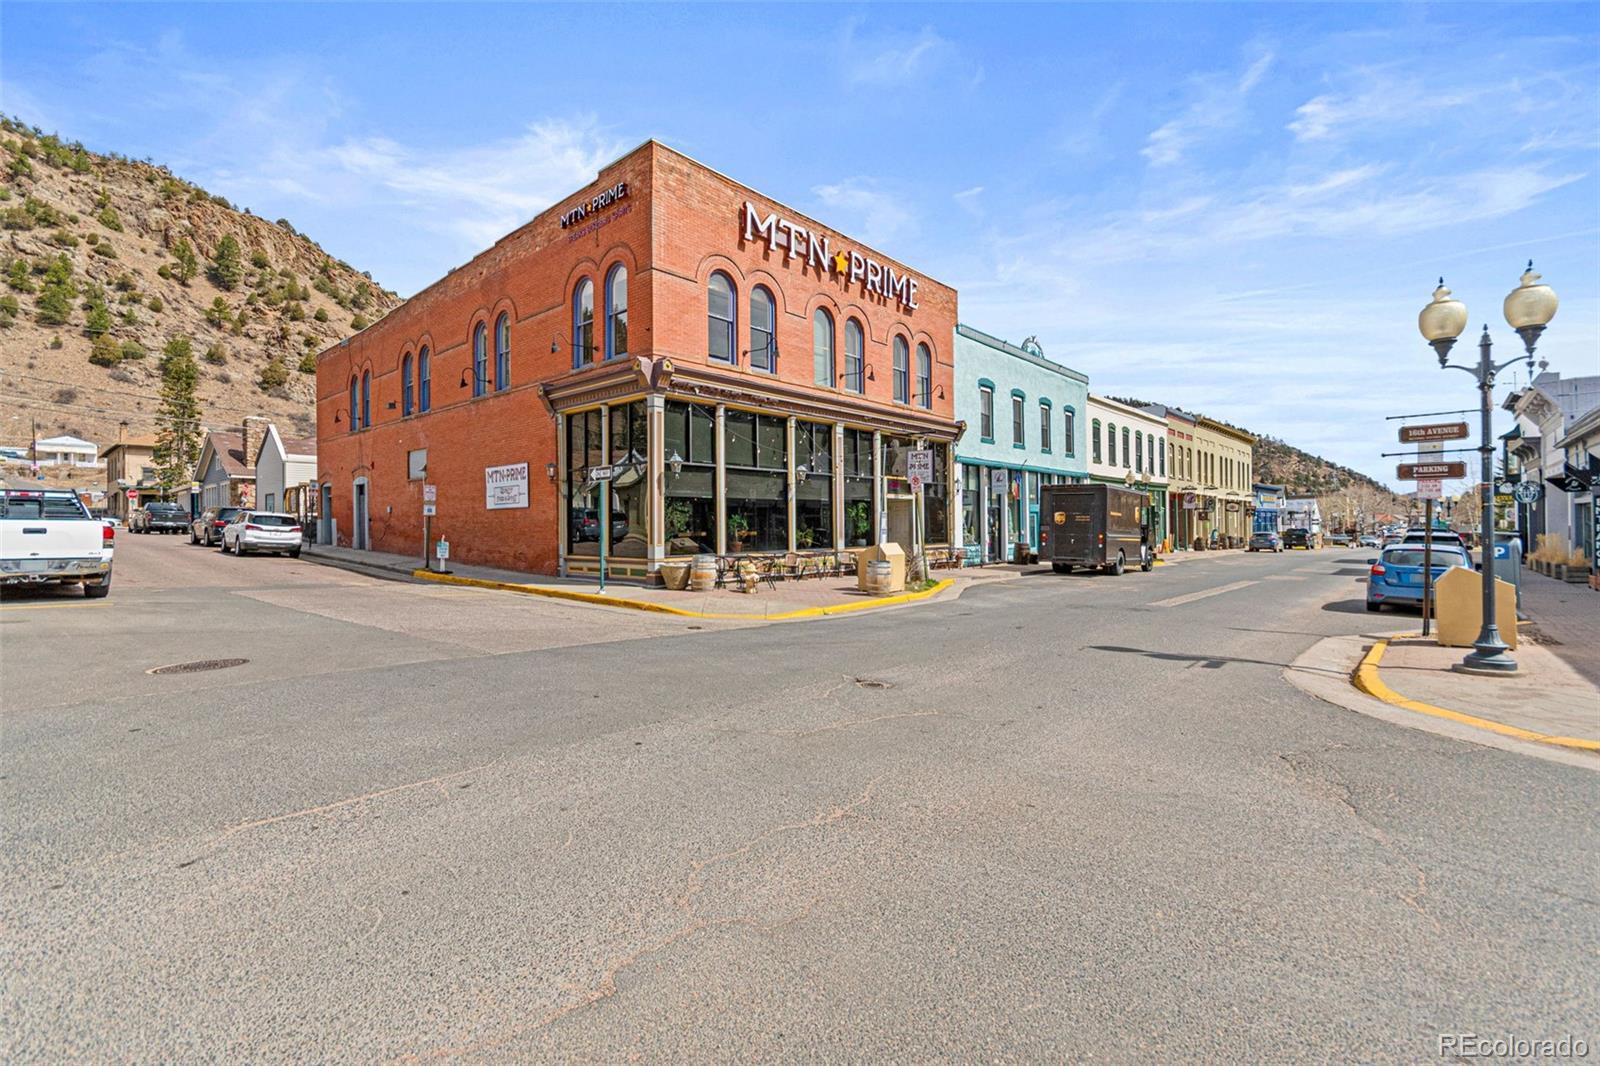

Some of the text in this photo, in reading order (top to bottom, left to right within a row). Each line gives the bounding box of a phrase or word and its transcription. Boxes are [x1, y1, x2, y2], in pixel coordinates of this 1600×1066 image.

[560, 202, 586, 229] MTN
[592, 182, 625, 212] PRIME
[743, 200, 919, 311] MTN PRIME
[1408, 429, 1426, 437] 16th
[1426, 426, 1460, 435] AVENUE
[911, 452, 929, 460] MTN
[1412, 465, 1449, 473] PARKING
